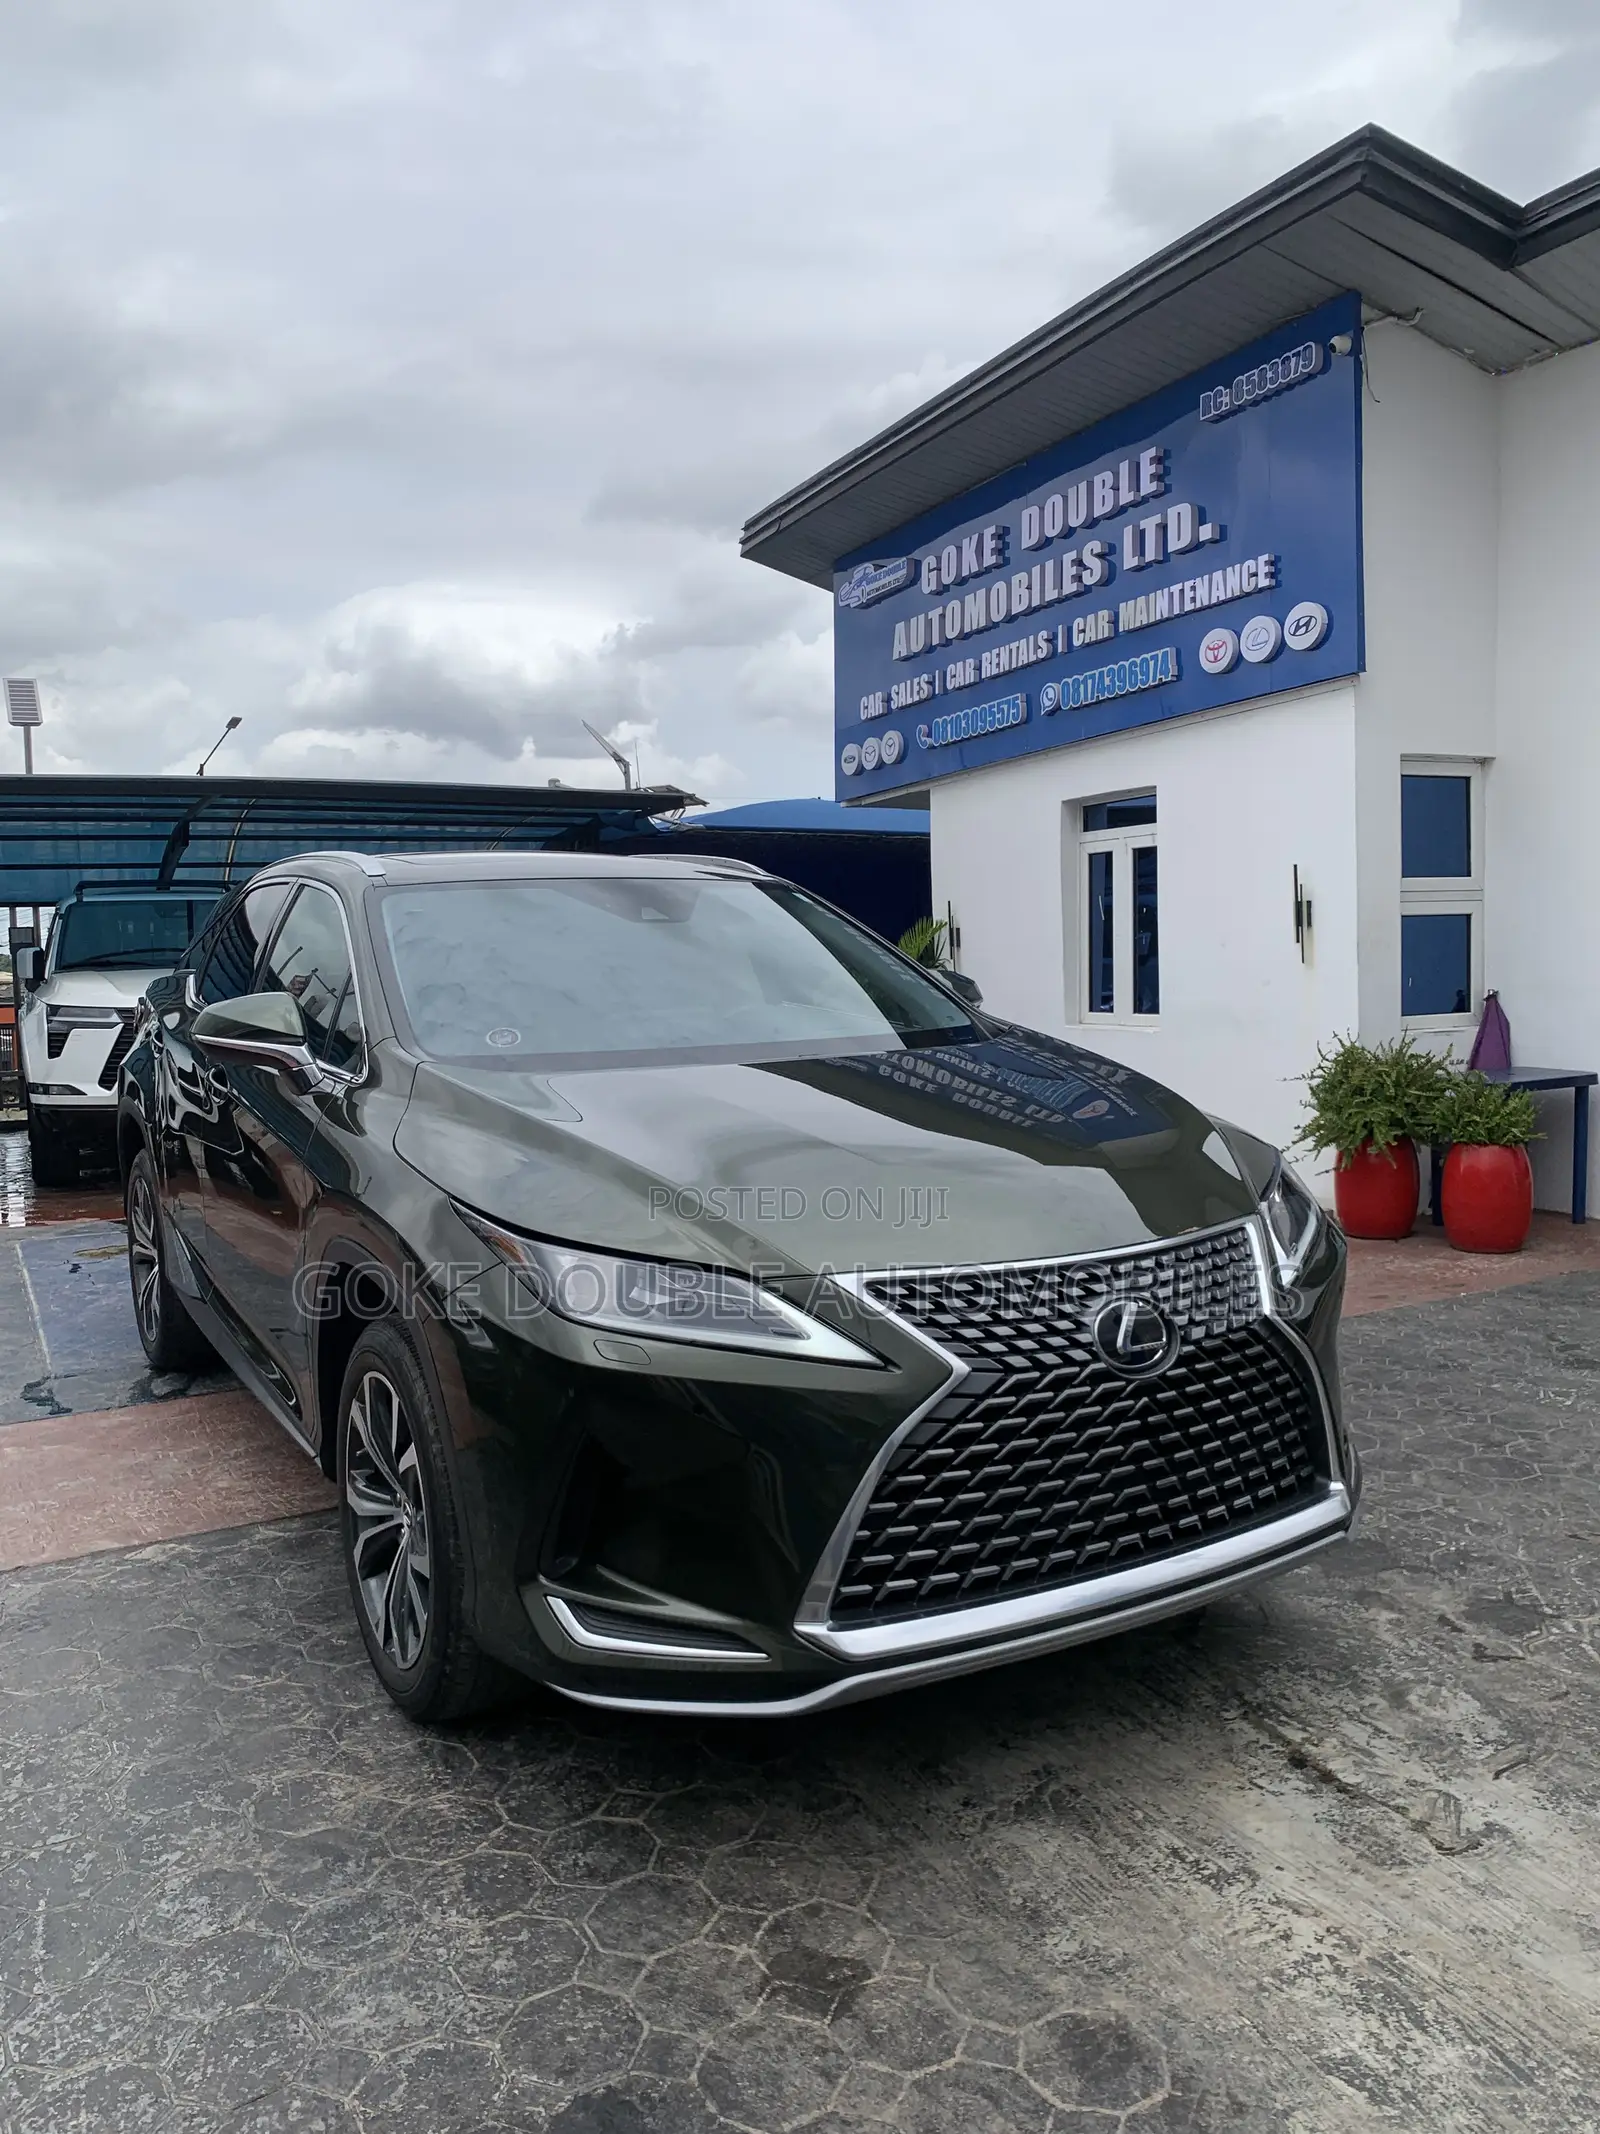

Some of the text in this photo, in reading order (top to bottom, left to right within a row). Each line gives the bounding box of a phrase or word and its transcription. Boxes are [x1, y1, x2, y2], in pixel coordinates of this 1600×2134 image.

[1200, 386, 1230, 420] RC:
[892, 502, 1219, 661] AUTOMOBILES LTD.
[921, 446, 1163, 594] GOKE DOUBLE
[860, 691, 886, 720] CAR
[891, 674, 931, 710] SALES
[946, 658, 977, 690] CAR
[981, 631, 1051, 679] RENTALS
[1072, 608, 1113, 647] CAR
[1119, 553, 1274, 631] MAINTENANCE
[931, 648, 1175, 747] 08103095575 08174396974
